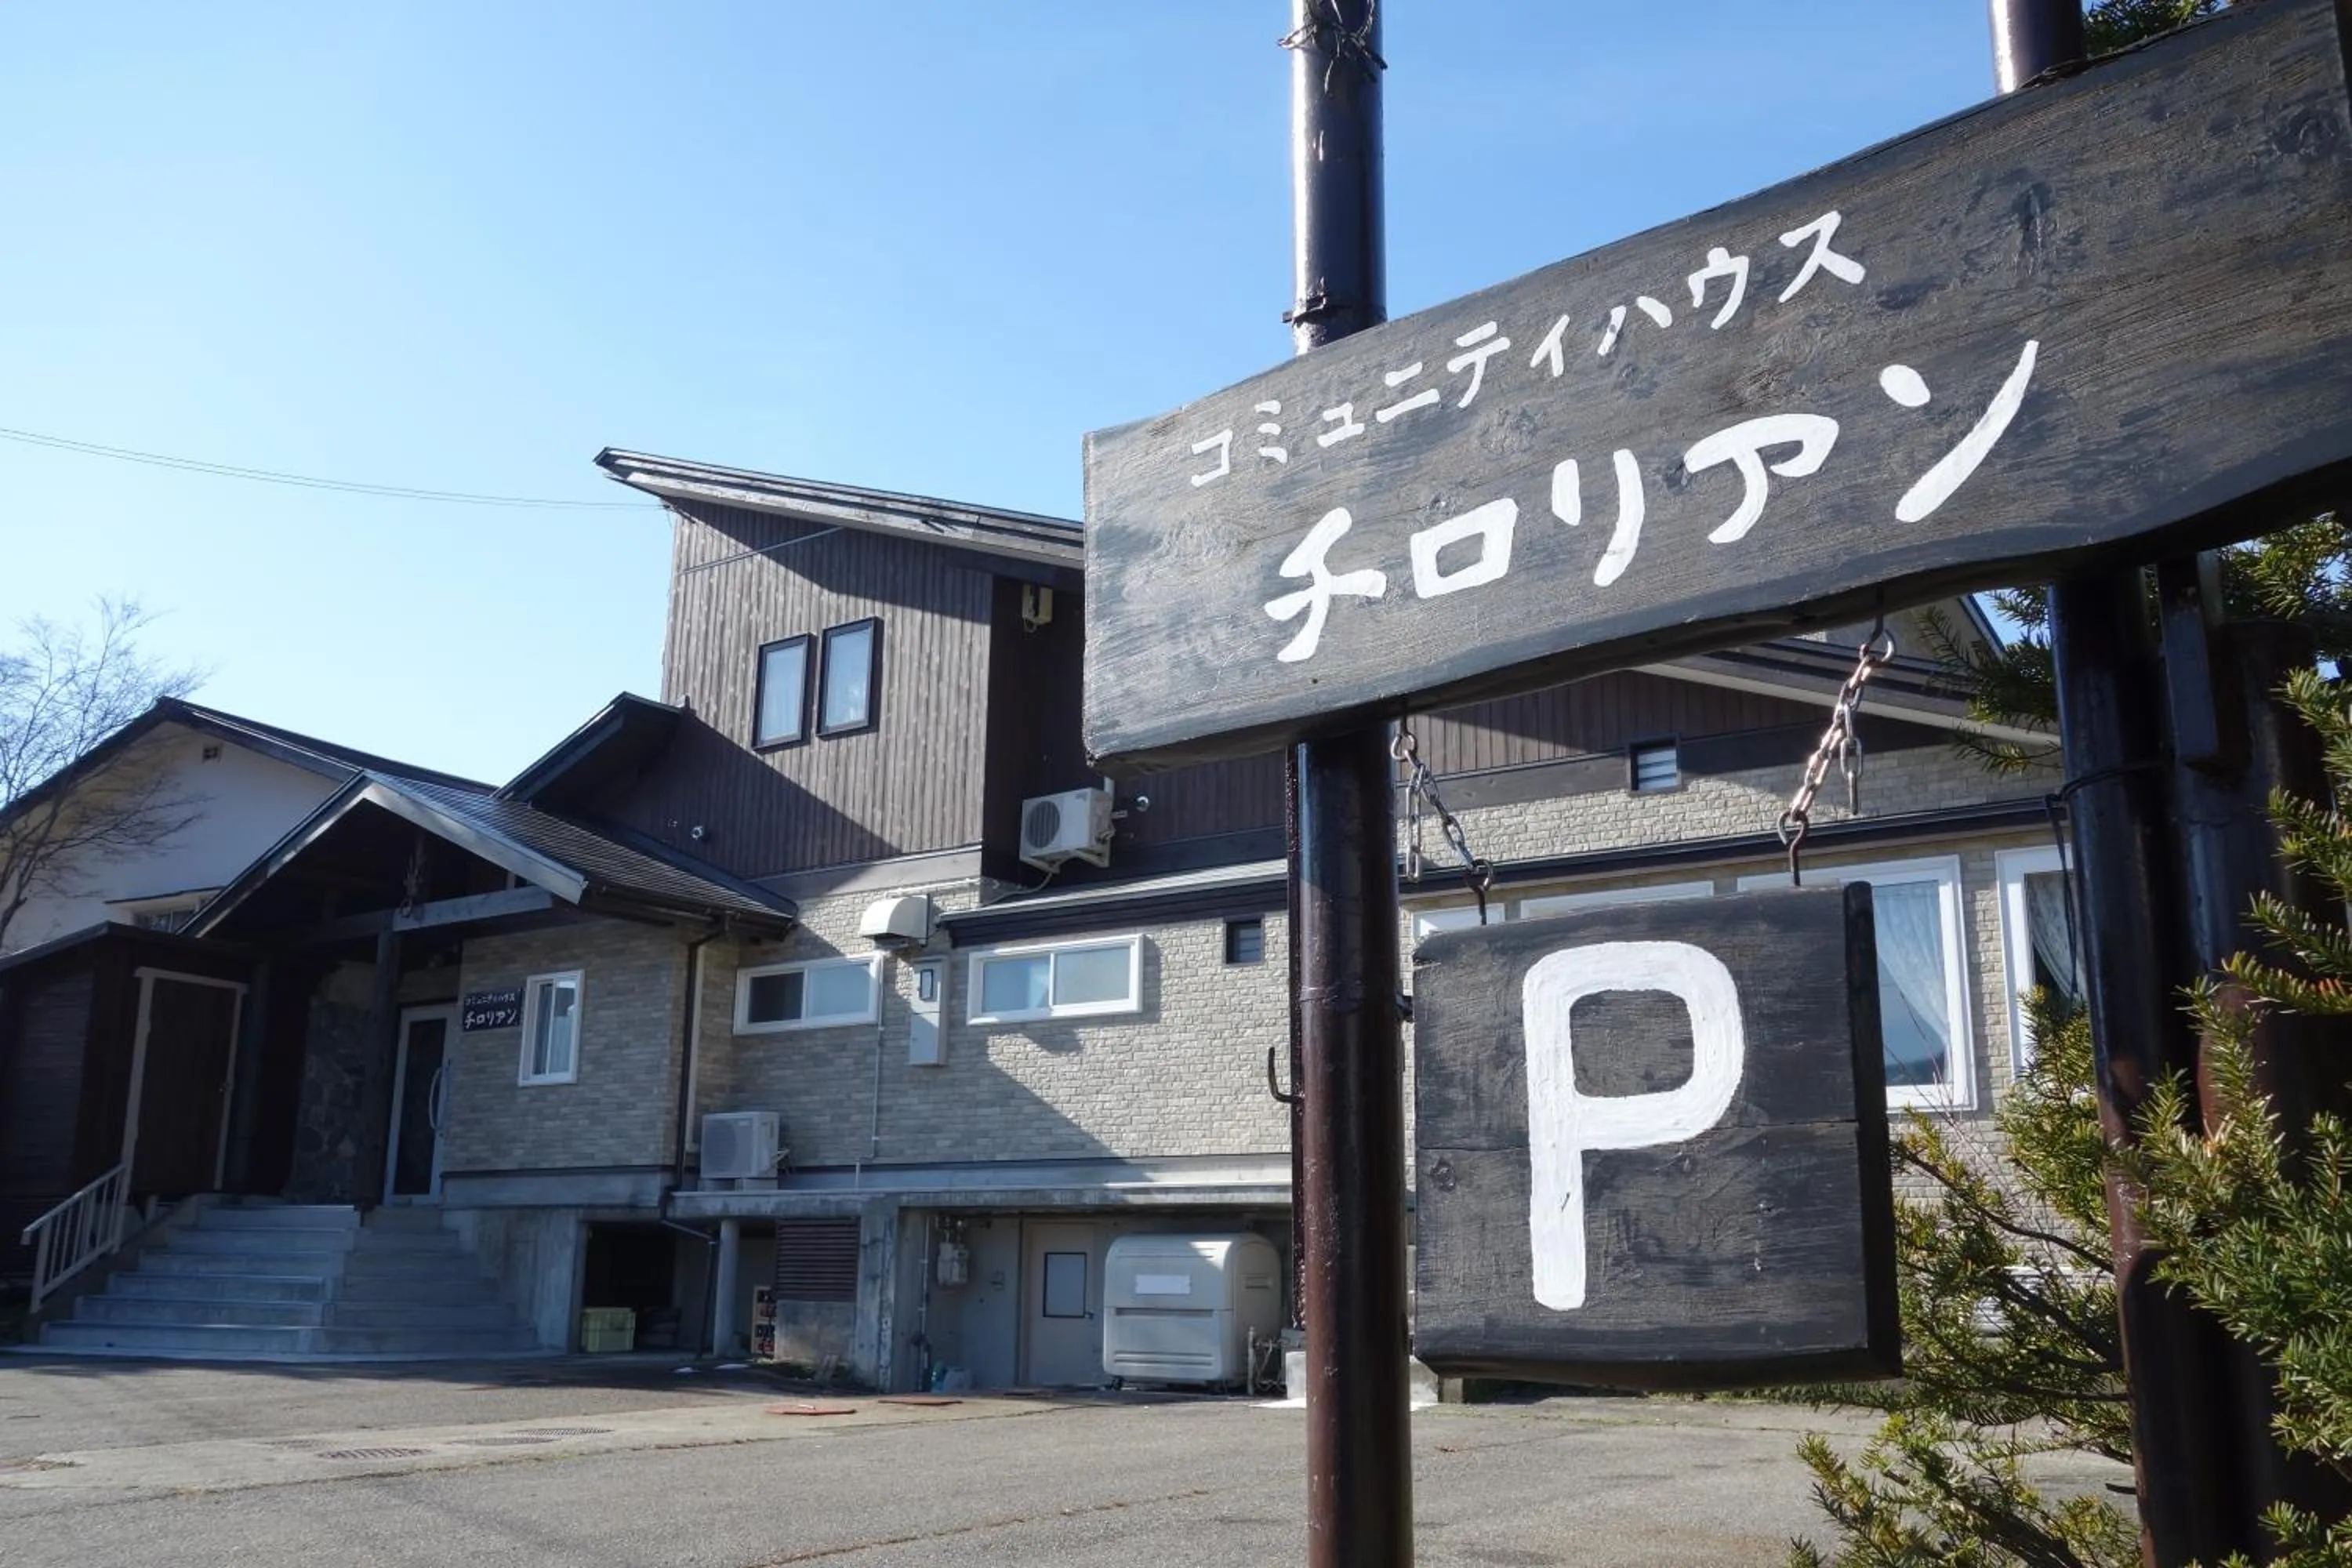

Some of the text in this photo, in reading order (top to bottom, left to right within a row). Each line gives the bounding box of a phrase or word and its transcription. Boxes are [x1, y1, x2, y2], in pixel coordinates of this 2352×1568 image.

[1263, 339, 2038, 662] チロリアン
[464, 1007, 517, 1029] チロリアン
[1522, 941, 1744, 1311] P
